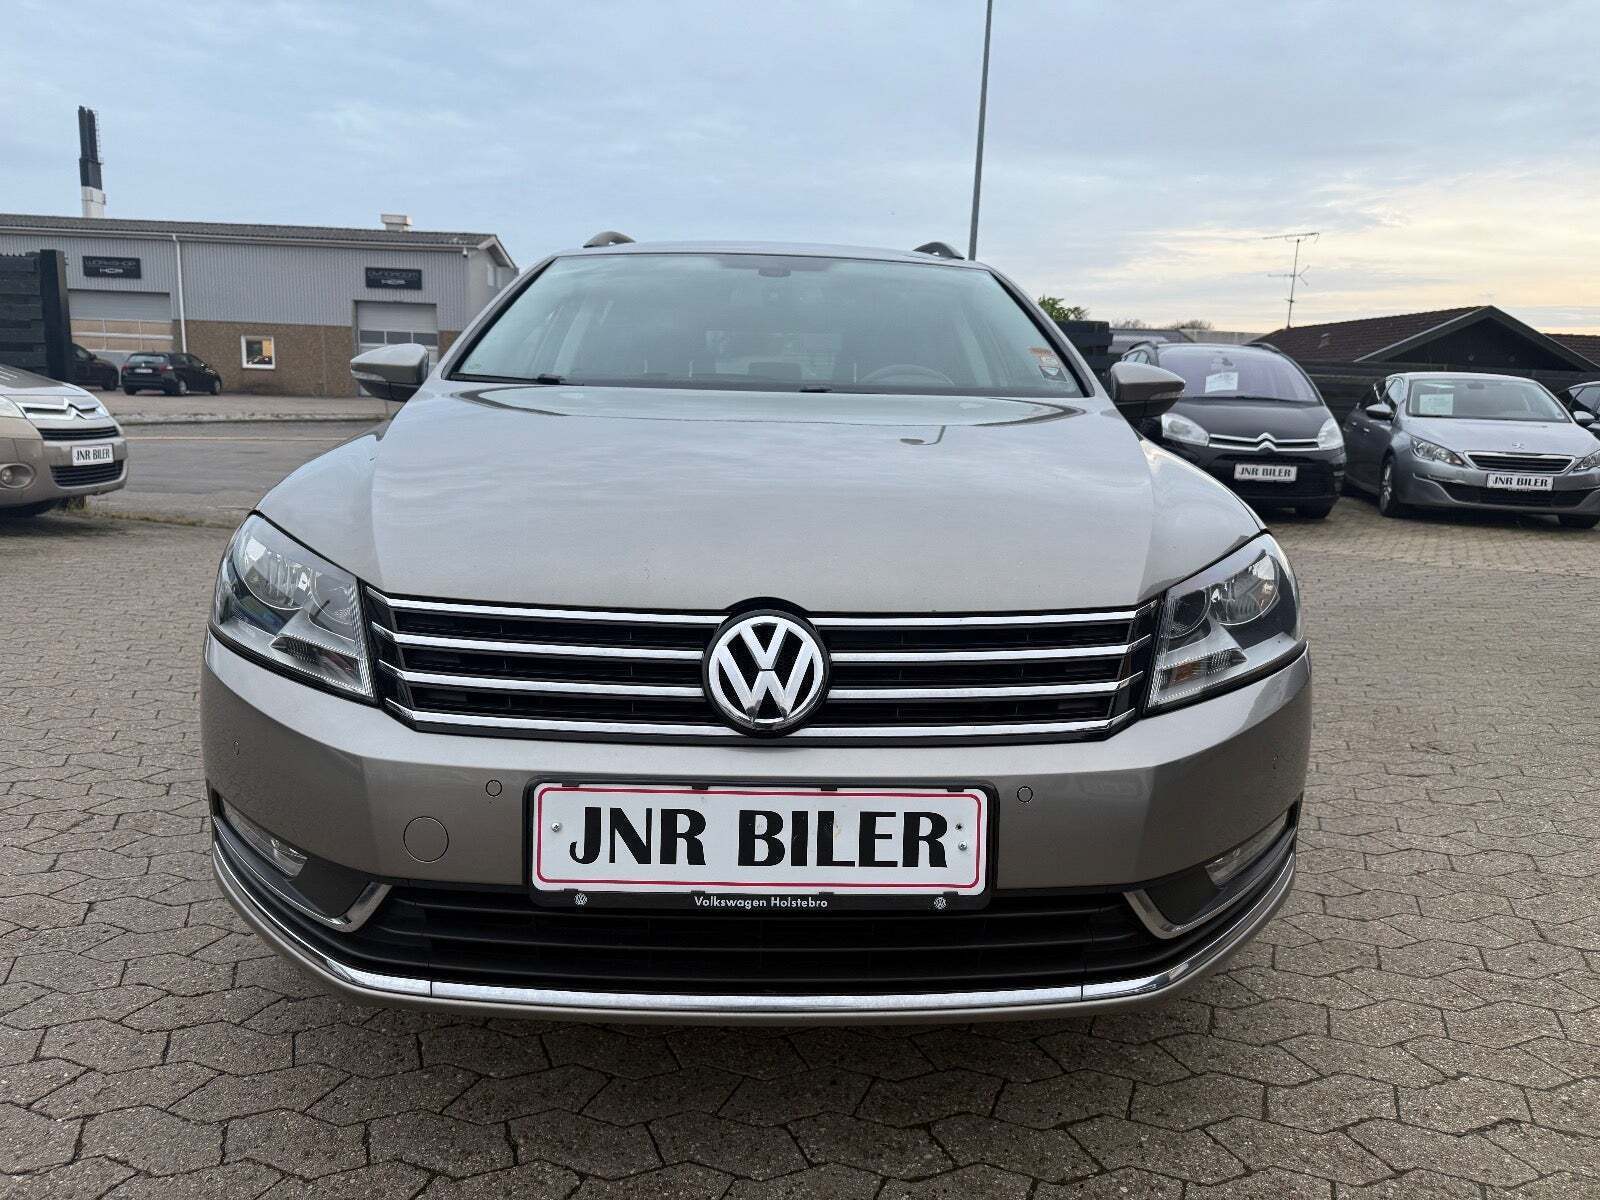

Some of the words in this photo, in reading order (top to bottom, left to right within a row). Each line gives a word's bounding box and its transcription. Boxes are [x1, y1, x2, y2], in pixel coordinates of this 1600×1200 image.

[75, 449, 91, 461] JNR
[92, 448, 110, 460] BILER
[1239, 467, 1258, 476] JNR
[1262, 468, 1291, 477] BILER
[1493, 476, 1513, 485] JNR
[1516, 477, 1548, 487] BILER
[569, 806, 707, 866] JNR
[737, 809, 949, 868] BILER
[694, 895, 767, 909] Volkswagen
[770, 896, 828, 908] Holstebro
